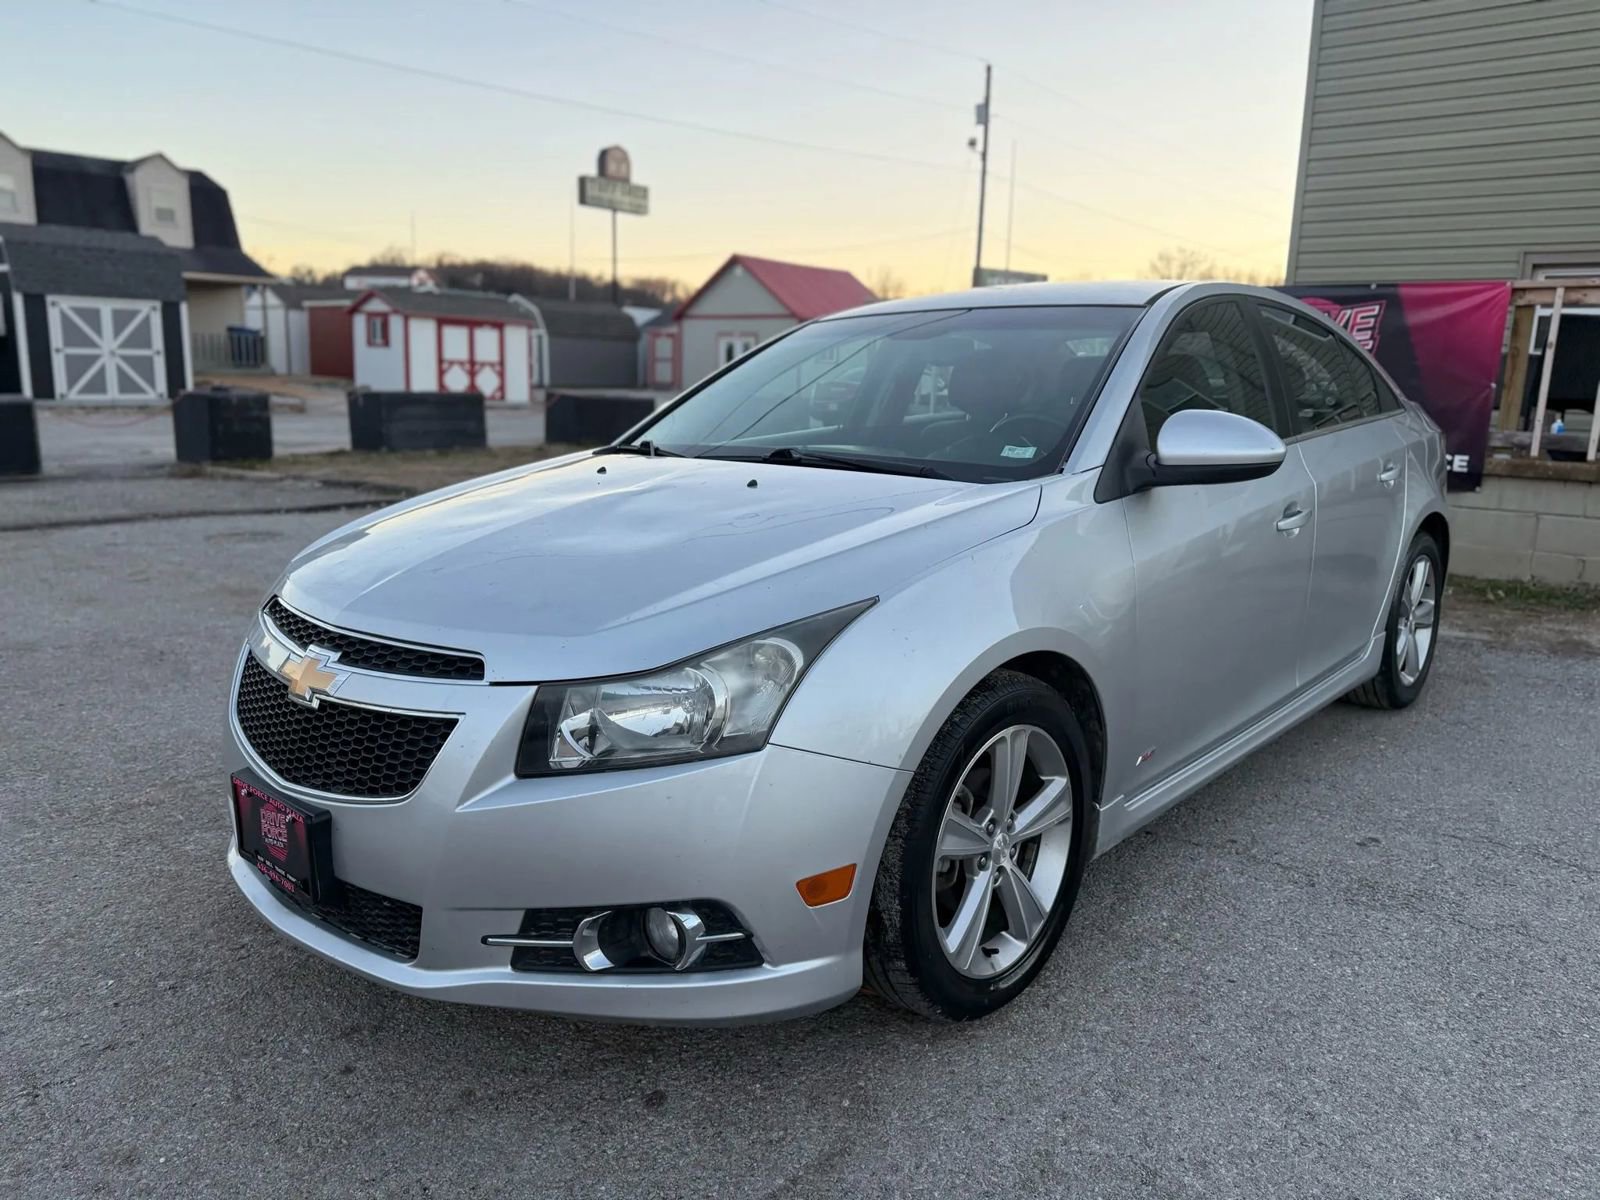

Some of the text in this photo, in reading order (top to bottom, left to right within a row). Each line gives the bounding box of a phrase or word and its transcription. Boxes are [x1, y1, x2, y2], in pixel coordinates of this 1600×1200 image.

[249, 788, 268, 801] FORCE
[269, 797, 285, 811] AUTO
[260, 808, 286, 828] DRIVE
[261, 825, 288, 843] FORCE
